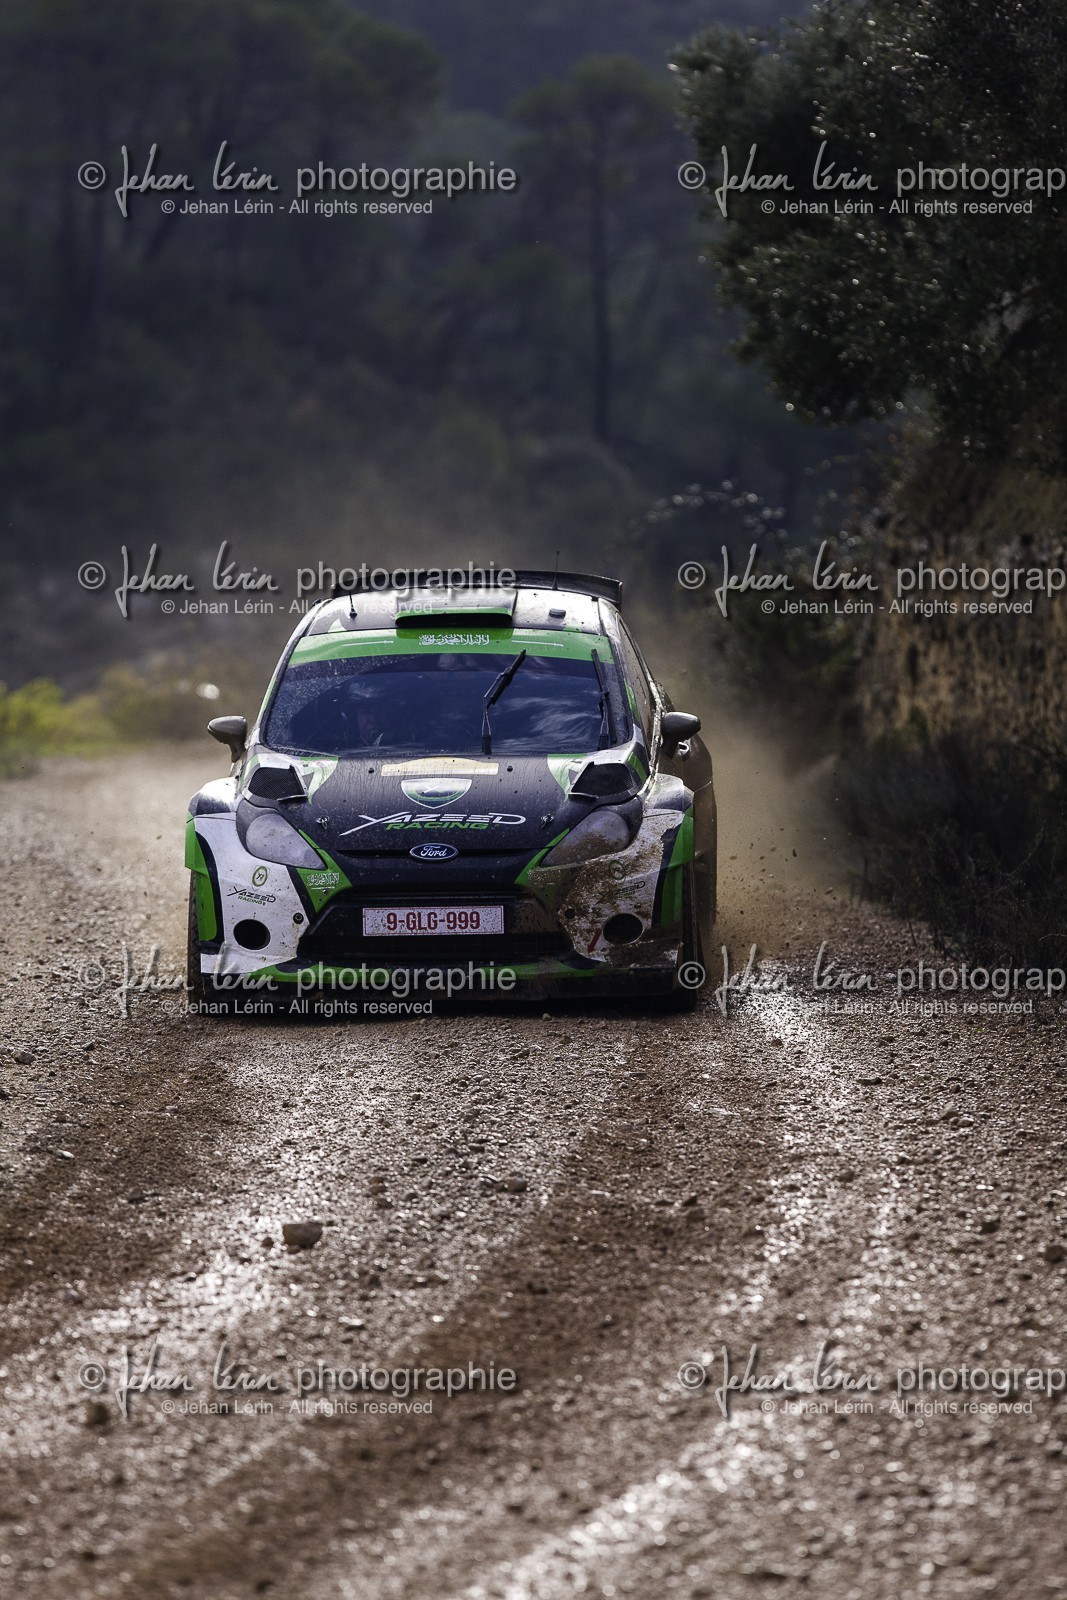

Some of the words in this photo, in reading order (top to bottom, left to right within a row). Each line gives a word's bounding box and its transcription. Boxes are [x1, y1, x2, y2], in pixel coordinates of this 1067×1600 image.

[339, 811, 526, 836] YAZEED
[386, 822, 489, 831] RACING
[420, 845, 447, 857] Ford
[386, 911, 480, 931] 9-GLG-999
